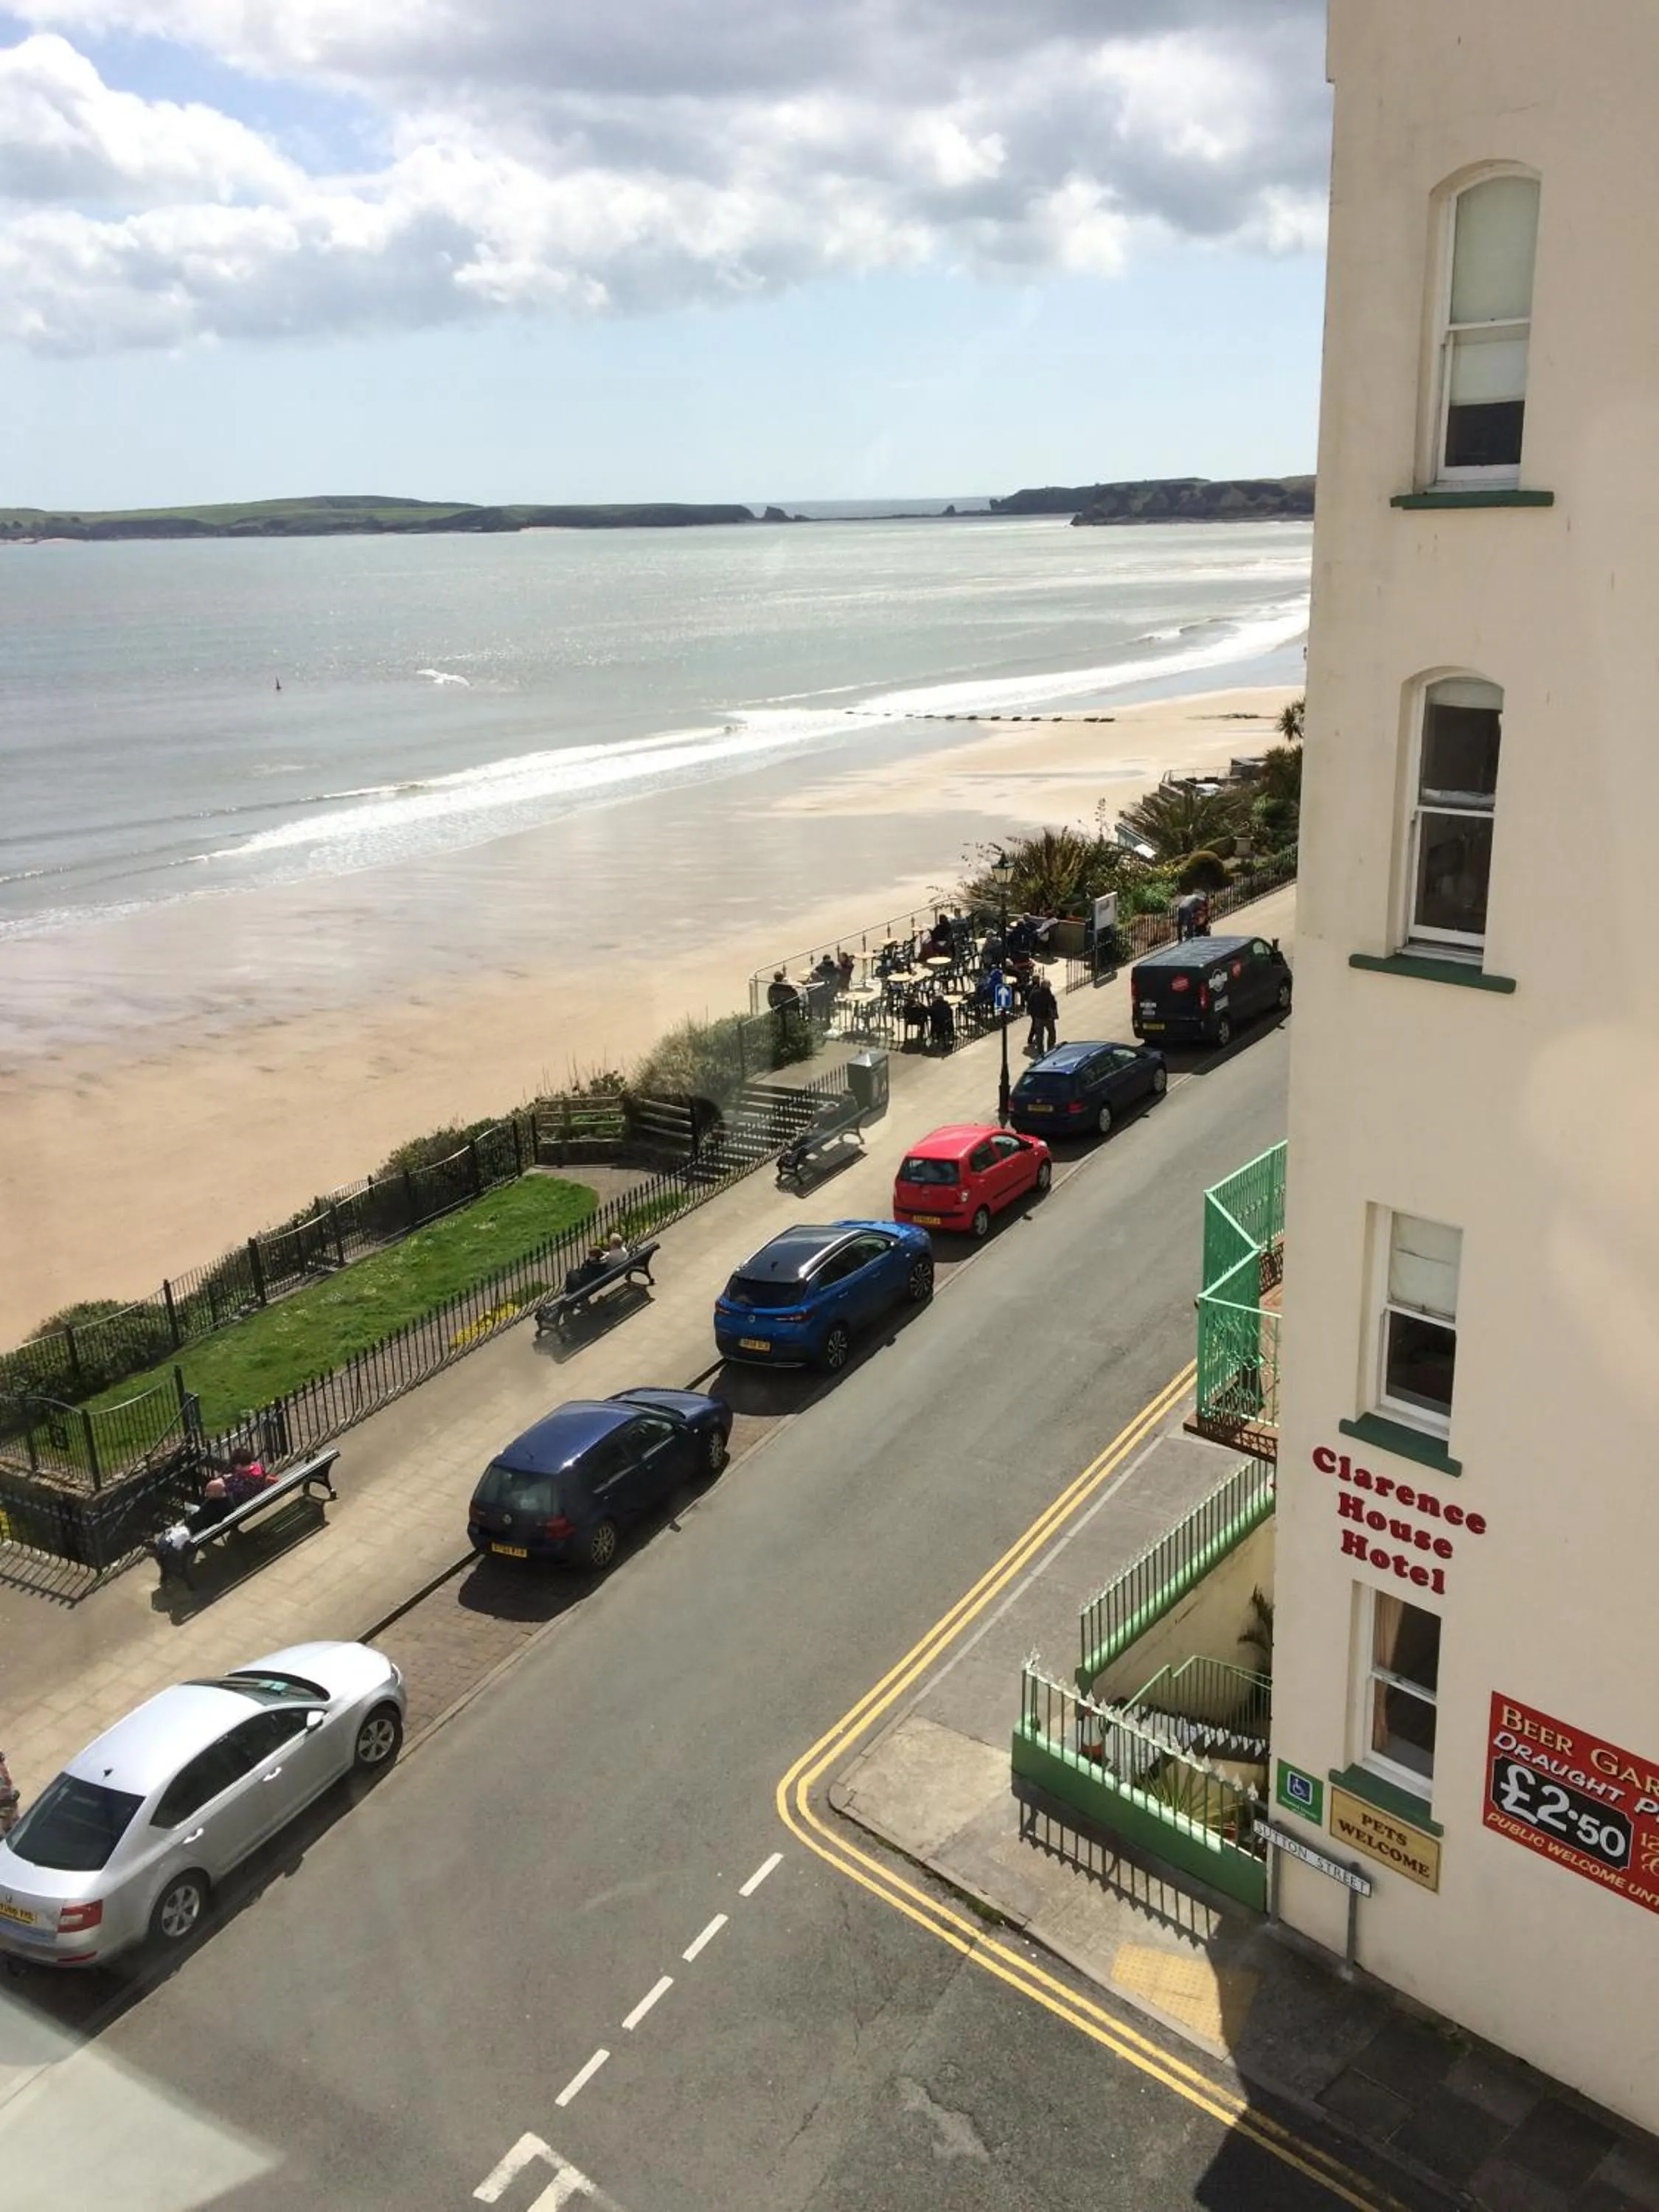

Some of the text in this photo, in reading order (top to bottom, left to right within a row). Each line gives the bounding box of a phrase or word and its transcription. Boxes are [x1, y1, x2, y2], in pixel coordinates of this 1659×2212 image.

[1312, 1447, 1486, 1534] Clarence
[1338, 1492, 1453, 1559] House
[1340, 1528, 1445, 1595] Hotel
[1500, 1705, 1574, 1757] BEER
[1493, 1731, 1625, 1803] DRAUGHT
[1254, 1822, 1365, 1892] SUTTON STREET
[1338, 1818, 1430, 1879] WELCOME
[1361, 1812, 1408, 1846] PETS
[1486, 1812, 1545, 1848] PUBLIC
[1547, 1842, 1627, 1888] WELCOME
